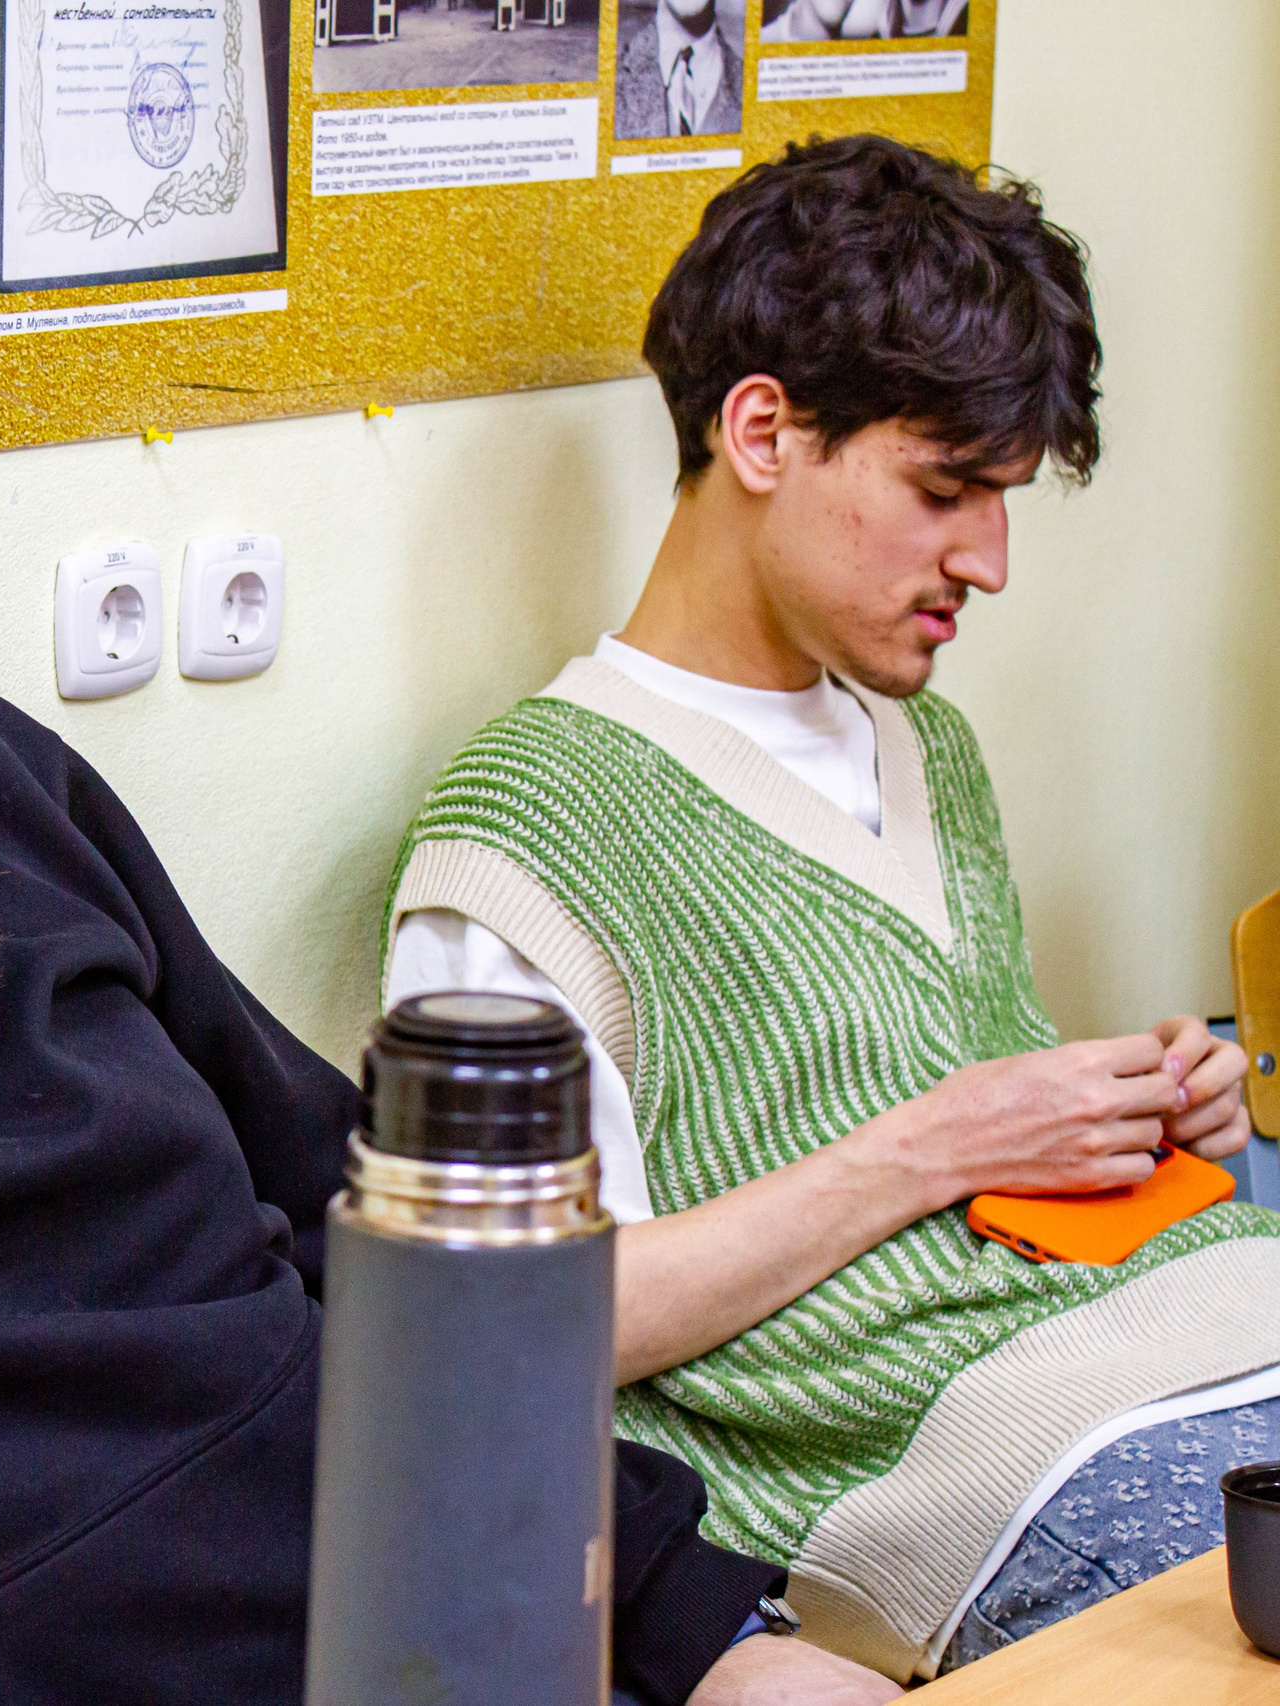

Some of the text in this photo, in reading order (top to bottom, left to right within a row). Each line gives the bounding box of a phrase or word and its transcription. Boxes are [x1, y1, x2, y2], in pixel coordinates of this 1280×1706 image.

[54, 2, 216, 20] жественной самодеятельности
[16, 318, 24, 330] В.
[27, 317, 69, 330] Мулявина,
[73, 309, 127, 323] подписанный
[129, 307, 181, 322] директором
[237, 542, 255, 552] 220 V
[107, 552, 126, 563] 220 V
